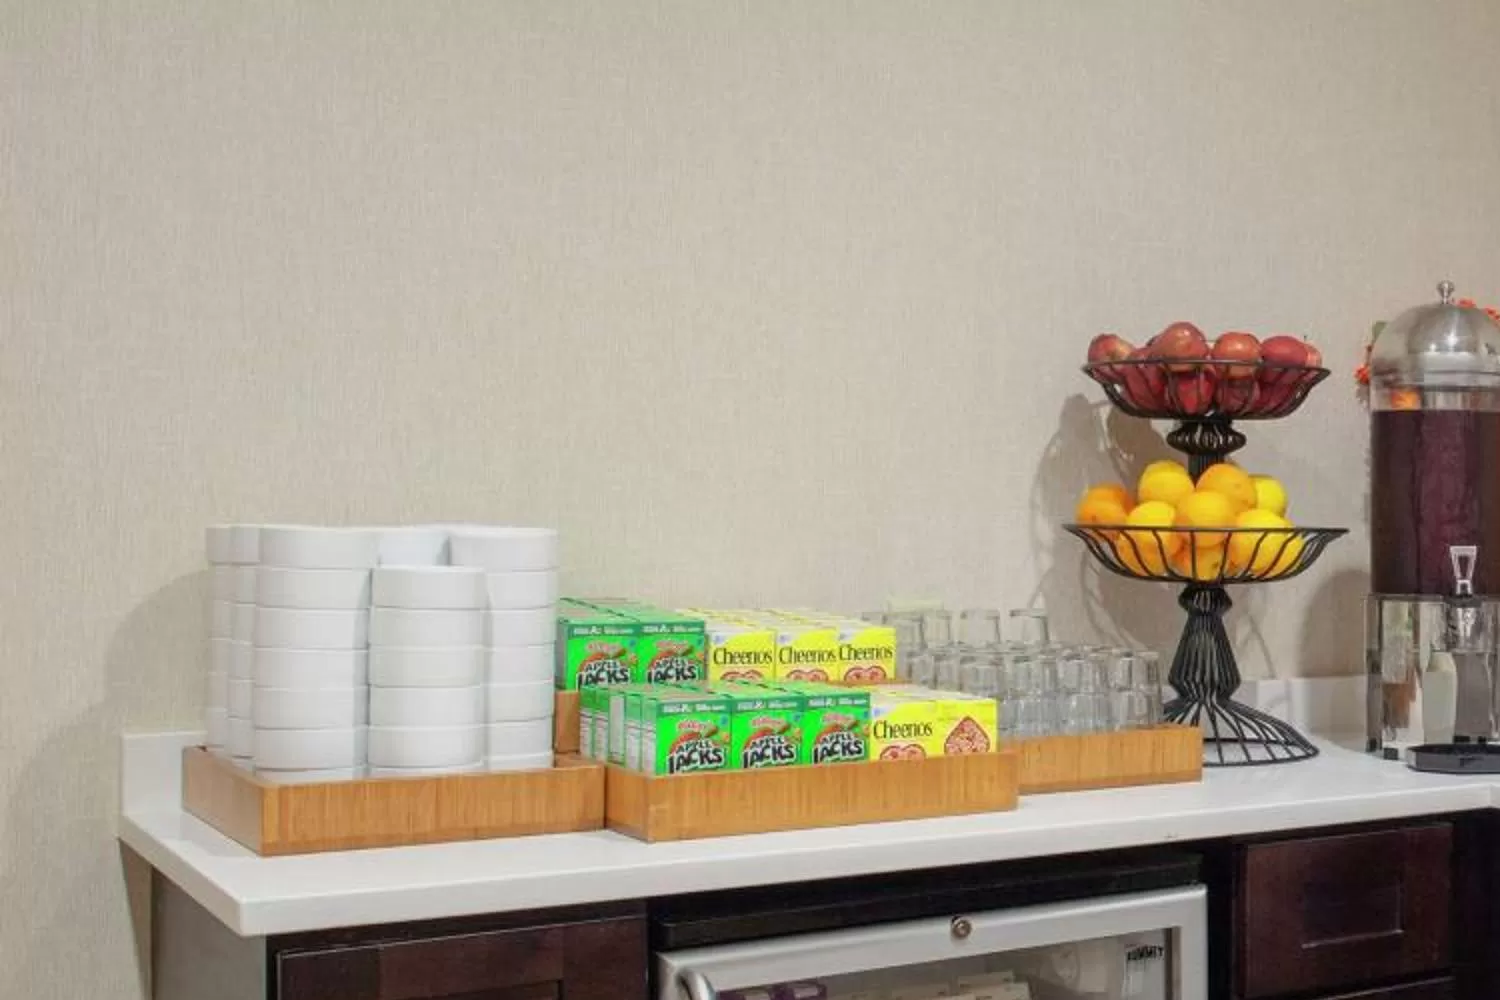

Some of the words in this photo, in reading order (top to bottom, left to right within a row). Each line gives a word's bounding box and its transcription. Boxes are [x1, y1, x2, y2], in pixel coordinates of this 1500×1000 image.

[713, 648, 773, 665] Cheerios
[779, 647, 836, 664] Cheerios
[839, 644, 893, 661] Cheerios
[872, 720, 933, 739] Cheerios
[668, 748, 724, 774] JACKS
[742, 745, 796, 769] JACKS
[812, 741, 864, 764] JACKS
